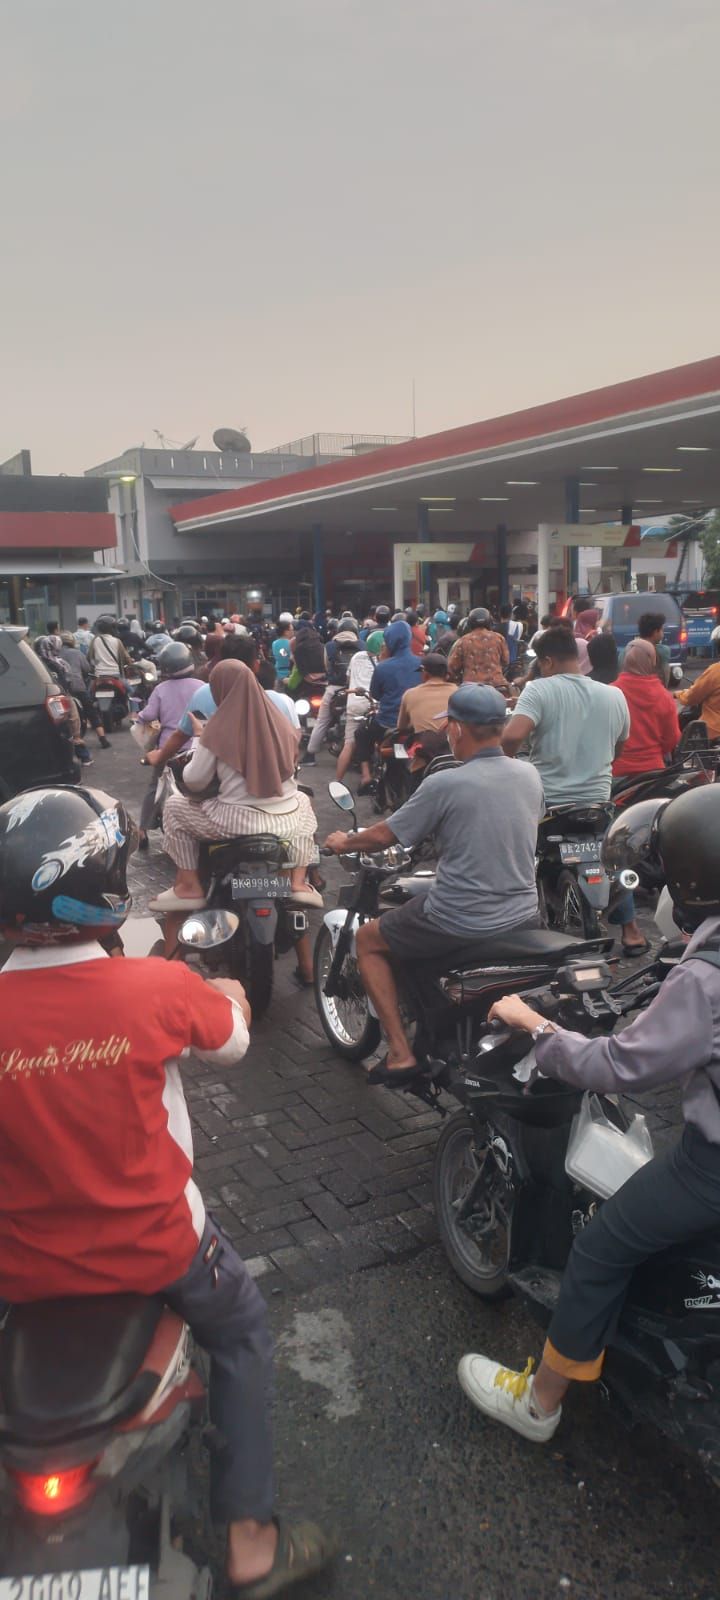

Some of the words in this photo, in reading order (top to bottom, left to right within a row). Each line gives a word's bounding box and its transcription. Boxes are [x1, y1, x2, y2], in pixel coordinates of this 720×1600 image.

[574, 842, 597, 853] 2742
[232, 878, 245, 889] BK
[0, 1047, 59, 1072] Louis
[62, 1034, 131, 1065] Philip
